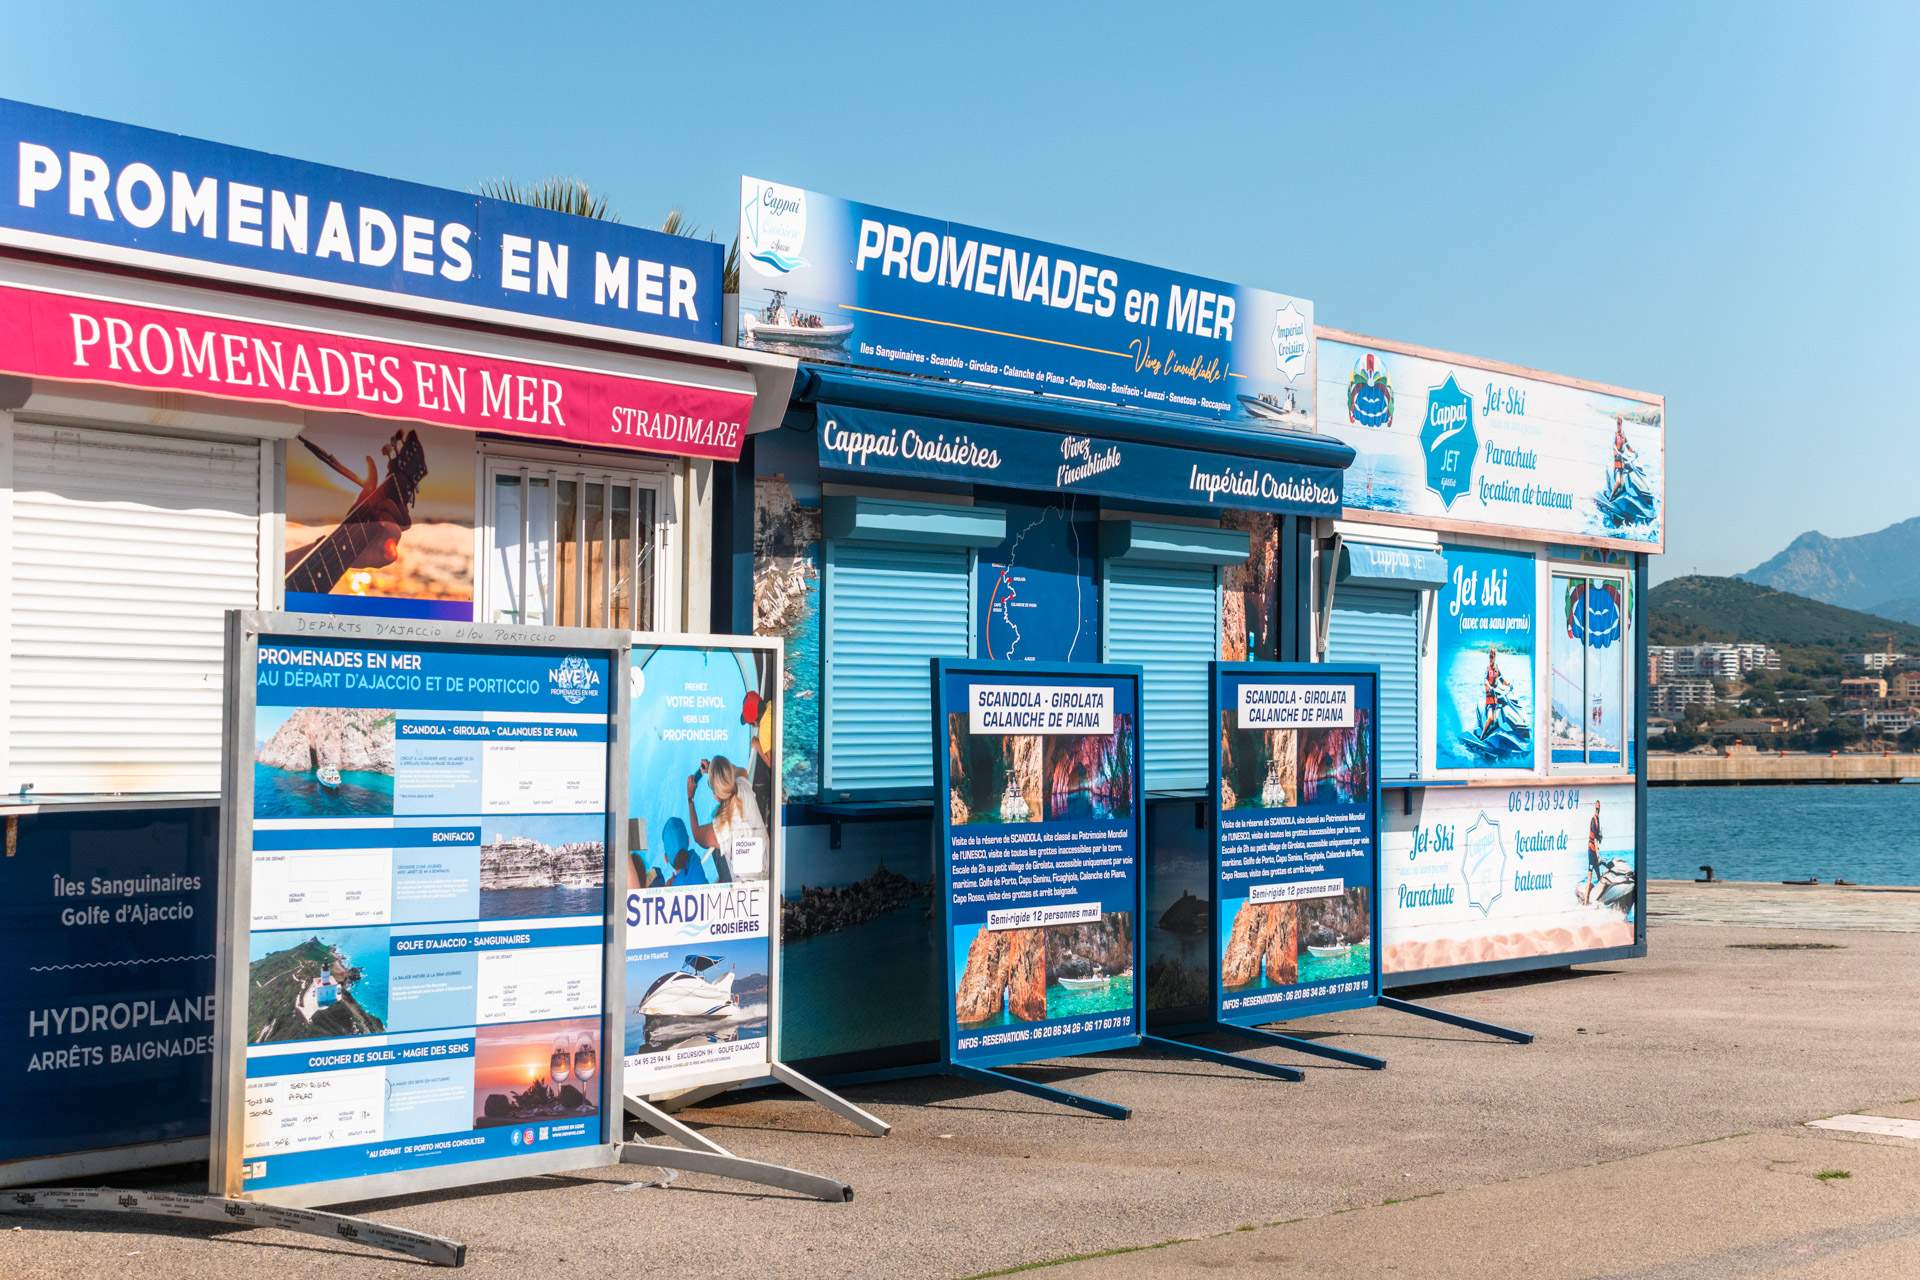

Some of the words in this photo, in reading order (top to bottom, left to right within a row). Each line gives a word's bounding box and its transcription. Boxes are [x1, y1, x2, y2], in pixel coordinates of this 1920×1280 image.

[763, 187, 801, 216] Cappai
[19, 141, 472, 282] PROMENADES
[501, 233, 568, 299] EN
[594, 251, 699, 321] MER
[856, 219, 1118, 317] PROMENADES
[1124, 287, 1160, 327] en
[1166, 284, 1236, 341] MER
[1129, 336, 1161, 375] Vivez
[69, 313, 402, 405] PROMENADES
[413, 361, 467, 416] EN
[480, 370, 565, 426] MER
[611, 406, 740, 447] STRADIMARE
[860, 342, 874, 355] Iles
[876, 345, 925, 363] Sanguinaires
[930, 354, 963, 368] Scandola
[969, 360, 998, 374] Girolata
[1003, 365, 1035, 379] Calanche
[1036, 370, 1044, 380] de
[1046, 372, 1064, 384] Piana
[1070, 376, 1086, 388] Capo
[1087, 379, 1106, 391] Rosso
[1112, 382, 1140, 396] Bonifacio
[1144, 388, 1165, 400] Lavezzi
[1169, 392, 1197, 406] Senetosa
[1201, 398, 1231, 411] Roccapina
[1430, 398, 1468, 431] Cappai
[1483, 383, 1526, 416] Jet-Ski
[823, 420, 899, 466] Cappai
[902, 429, 1001, 468] Croisières
[1060, 435, 1091, 460] Vivez
[1485, 440, 1537, 470] Parachute
[1057, 445, 1121, 487] l'inoubliable
[1441, 450, 1460, 472] JET
[1190, 464, 1259, 502] Impérial
[1261, 473, 1339, 504] Croisières
[1479, 475, 1520, 506] Location
[1522, 484, 1533, 504] de
[1536, 487, 1573, 509] bateaux
[1450, 565, 1477, 616] Jet
[1482, 568, 1507, 606] ski
[1460, 614, 1478, 634] (avec
[1480, 618, 1488, 629] ou
[1489, 617, 1505, 630] sans
[1505, 613, 1530, 634] permis)
[258, 648, 362, 668] PROMENADES
[367, 653, 386, 668] EN
[391, 654, 421, 670] MER
[258, 671, 278, 686] AU
[285, 669, 340, 688] DÉPART
[346, 673, 421, 691] D'AJACCIO
[426, 676, 442, 691] ET
[446, 677, 463, 692] DE
[469, 678, 540, 695] PORTICCIO
[666, 696, 694, 708] VOTRE
[697, 696, 726, 708] ENVOL
[979, 691, 1041, 707] SCANDOLA
[1051, 692, 1104, 708] GIROLATA
[1245, 690, 1296, 704] SCANDOLA
[1304, 691, 1347, 704] GIROLATA
[983, 712, 1044, 727] CALANCHE
[1048, 713, 1062, 727] DE
[1066, 713, 1100, 728] PIANA
[1249, 708, 1299, 722] CALANCHE
[1301, 708, 1313, 721] DE
[1316, 708, 1343, 721] PIANA
[402, 724, 445, 735] SCANDOLA
[453, 726, 490, 735] GIROLATA
[497, 727, 542, 736] CALANQUES
[544, 727, 554, 736] DE
[555, 728, 577, 737] PIANA
[663, 729, 728, 741] PROFONDEURS
[1508, 791, 1521, 812] 06
[1524, 791, 1535, 811] 21
[1538, 790, 1550, 811] 33
[1554, 790, 1565, 810] 92
[1568, 789, 1579, 809] 84
[432, 832, 475, 842] BONIFACIO
[1410, 824, 1455, 860] Jet-Ski
[1515, 829, 1554, 860] Location
[1557, 829, 1568, 850] de
[52, 873, 85, 897] Îles
[91, 874, 202, 897] Sanguinaires
[1252, 889, 1285, 901] Semi-rigide
[1287, 886, 1295, 895] 12
[1296, 884, 1326, 898] personnes
[1328, 882, 1341, 891] maxi
[1514, 870, 1552, 892] bateaux
[626, 889, 760, 927] STRADIMARE
[1398, 883, 1454, 909] Parachute
[61, 905, 111, 927] Golfe
[116, 901, 194, 925] d'Ajaccio
[990, 911, 1030, 925] Semi-rigide
[1033, 911, 1042, 921] 12
[1044, 908, 1080, 924] personnes
[1082, 905, 1098, 917] maxi
[397, 941, 424, 951] GOLFE
[425, 938, 467, 949] D'AJACCIO
[473, 934, 531, 947] SANGUINAIRES
[1222, 999, 1239, 1010] INFOS
[1242, 993, 1283, 1007] RESERVATIONS
[28, 995, 216, 1038] HYDROPLANE
[957, 1037, 978, 1050] INFOS
[982, 1030, 1029, 1046] RESERVATIONS
[1033, 1029, 1042, 1039] 06
[1043, 1028, 1052, 1037] 20
[1062, 1024, 1071, 1035] 34
[1072, 1022, 1080, 1033] 26
[1084, 1021, 1093, 1032] 06
[1094, 1020, 1102, 1030] 17
[1103, 1018, 1112, 1029] 60
[1113, 1017, 1121, 1027] 78
[1122, 1016, 1131, 1026] 19
[27, 1044, 104, 1073] ARRÊTS
[110, 1035, 215, 1064] BAIGNADES
[308, 1055, 351, 1067] COUCHER
[353, 1054, 364, 1063] DE
[367, 1052, 396, 1062] SOLEIL
[403, 1048, 429, 1058] MAGIE
[430, 1046, 447, 1056] DES
[448, 1043, 469, 1054] SENS
[634, 1058, 641, 1066] 04
[677, 1050, 706, 1060] EXCURSION
[718, 1045, 734, 1054] GOLFE
[404, 1145, 413, 1154] DE
[451, 1136, 485, 1148] CONSULTER
